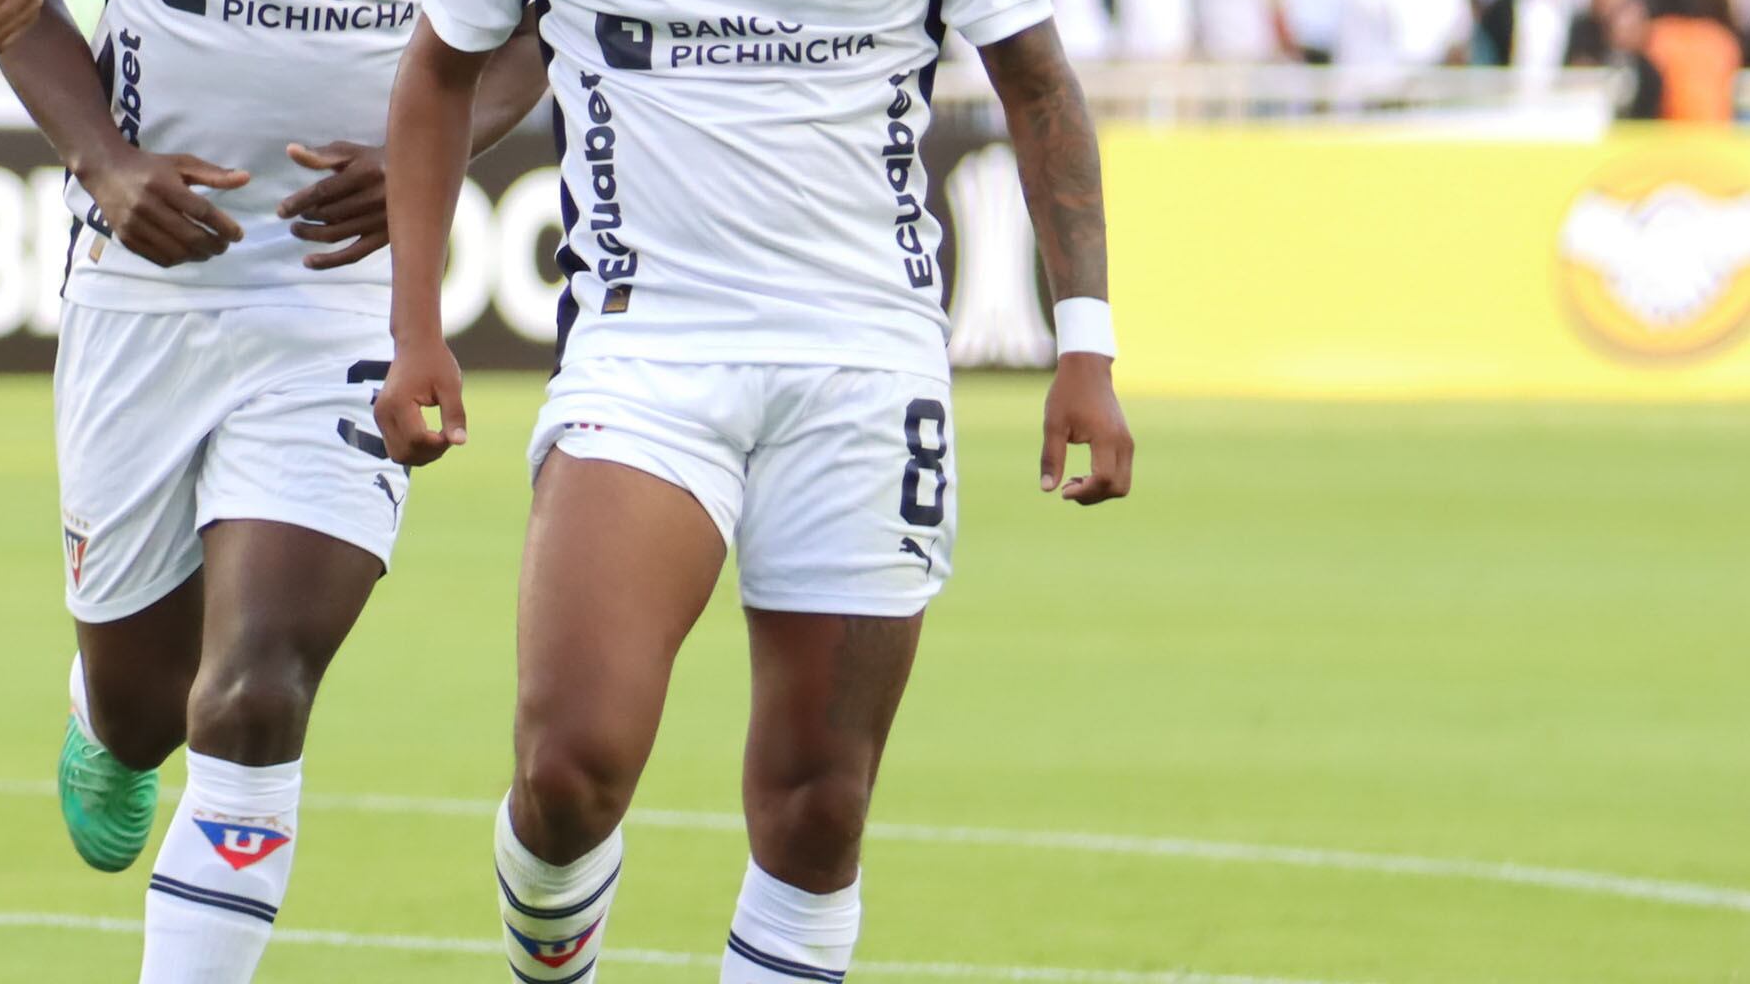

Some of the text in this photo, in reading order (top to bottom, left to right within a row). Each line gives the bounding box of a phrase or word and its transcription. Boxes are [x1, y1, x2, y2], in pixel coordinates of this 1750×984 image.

[671, 33, 876, 68] PICHINCHA
[900, 398, 948, 527] 8
[223, 829, 266, 854] U
